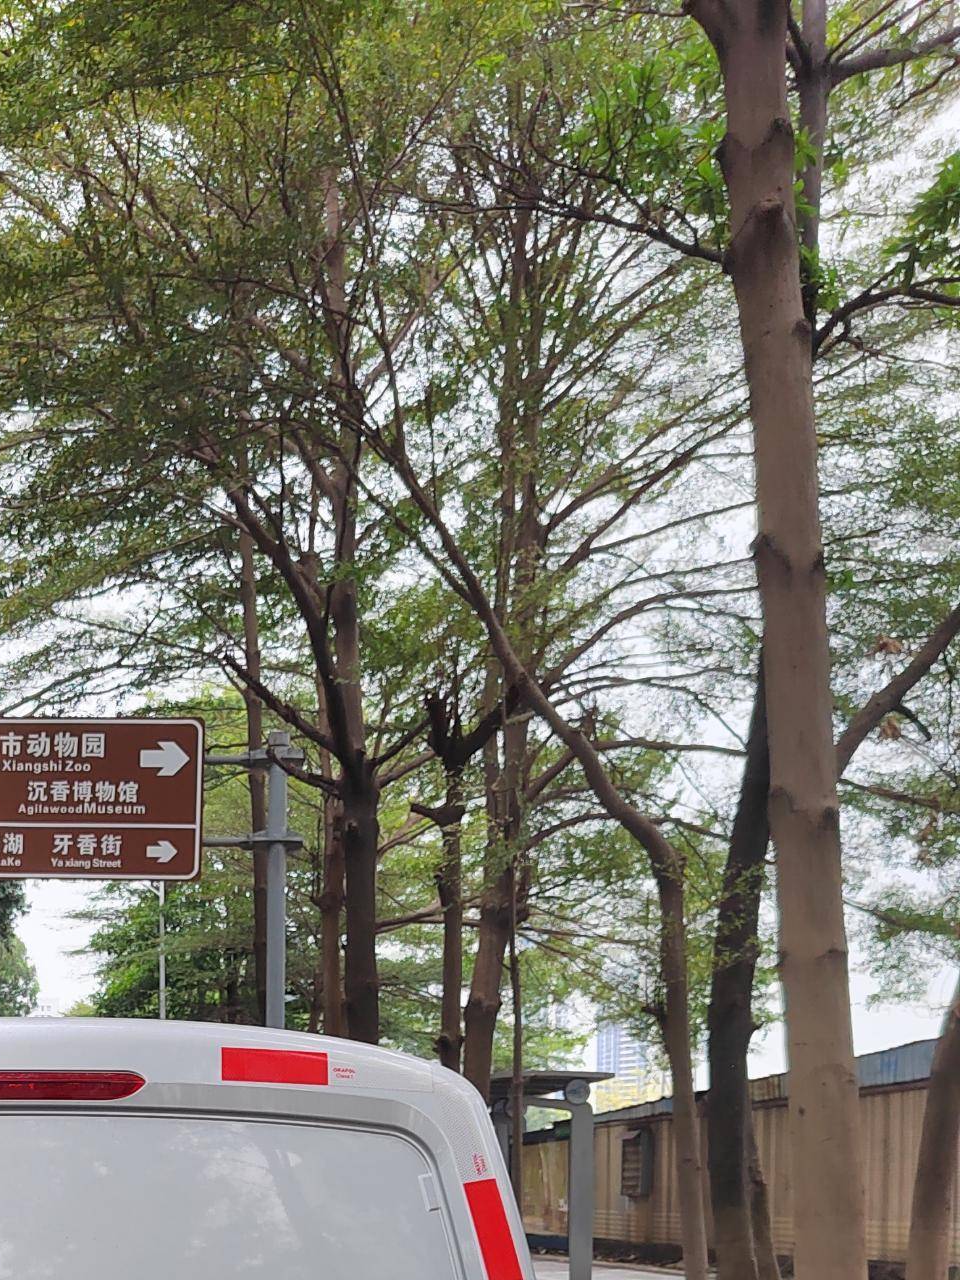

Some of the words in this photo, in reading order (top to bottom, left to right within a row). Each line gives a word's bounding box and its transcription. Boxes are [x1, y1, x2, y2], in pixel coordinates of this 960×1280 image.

[2, 759, 62, 774] Xiangshi
[64, 760, 91, 772] Zoo
[27, 780, 139, 803] 沉香博物馆
[52, 834, 123, 857] 牙香街
[92, 858, 122, 868] Street
